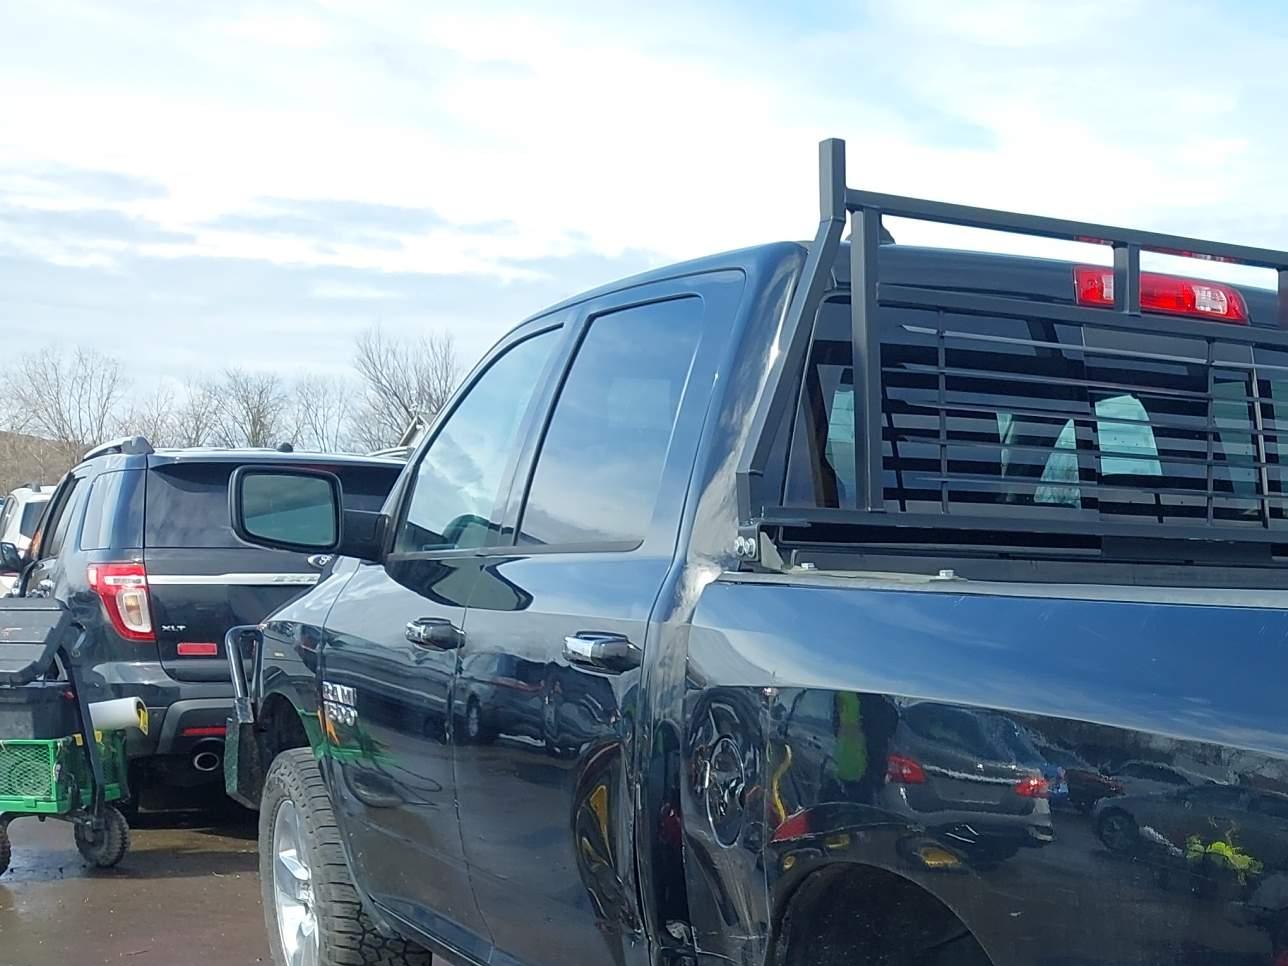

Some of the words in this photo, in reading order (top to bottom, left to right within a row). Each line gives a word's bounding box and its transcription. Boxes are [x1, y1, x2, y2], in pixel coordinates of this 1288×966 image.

[161, 624, 187, 633] XLT
[322, 681, 358, 707] RAM
[322, 701, 359, 727] 1500
